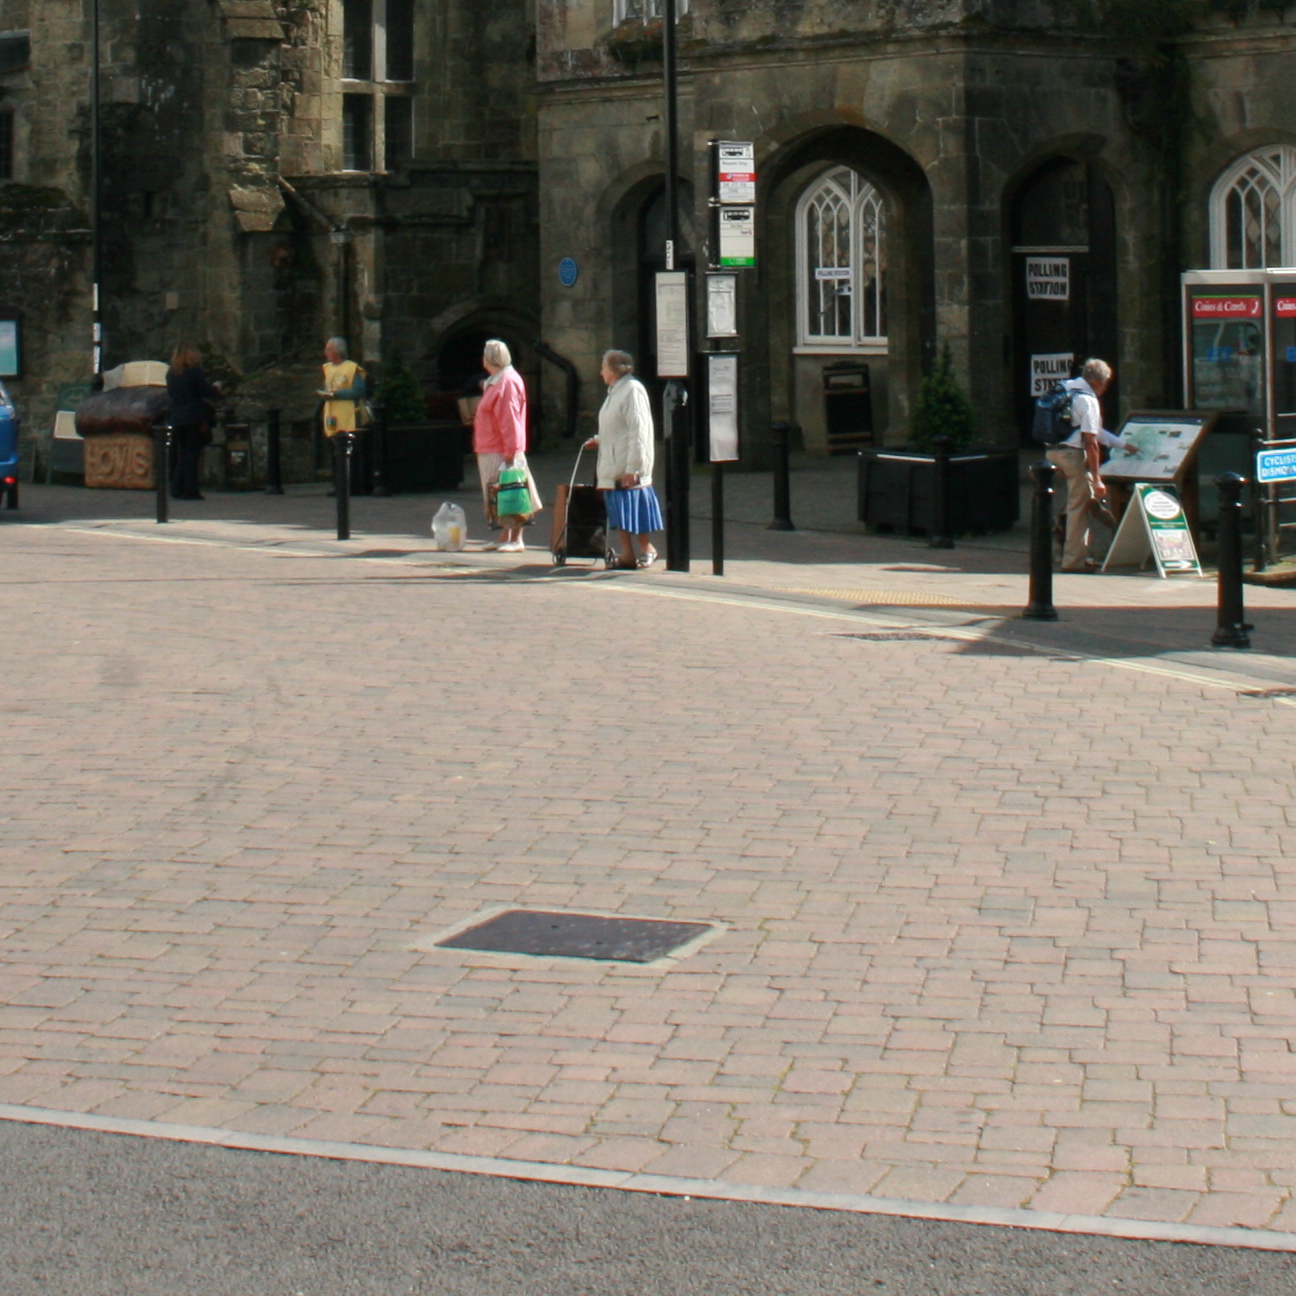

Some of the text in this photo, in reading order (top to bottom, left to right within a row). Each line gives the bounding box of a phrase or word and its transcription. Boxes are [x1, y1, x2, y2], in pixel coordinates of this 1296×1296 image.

[1028, 263, 1068, 278] POLLING
[1028, 281, 1068, 296] STATION
[1195, 300, 1247, 312] Coins & Cards
[1277, 300, 1292, 312] Coins
[1208, 347, 1232, 363] BT
[87, 445, 151, 479] HOVIS
